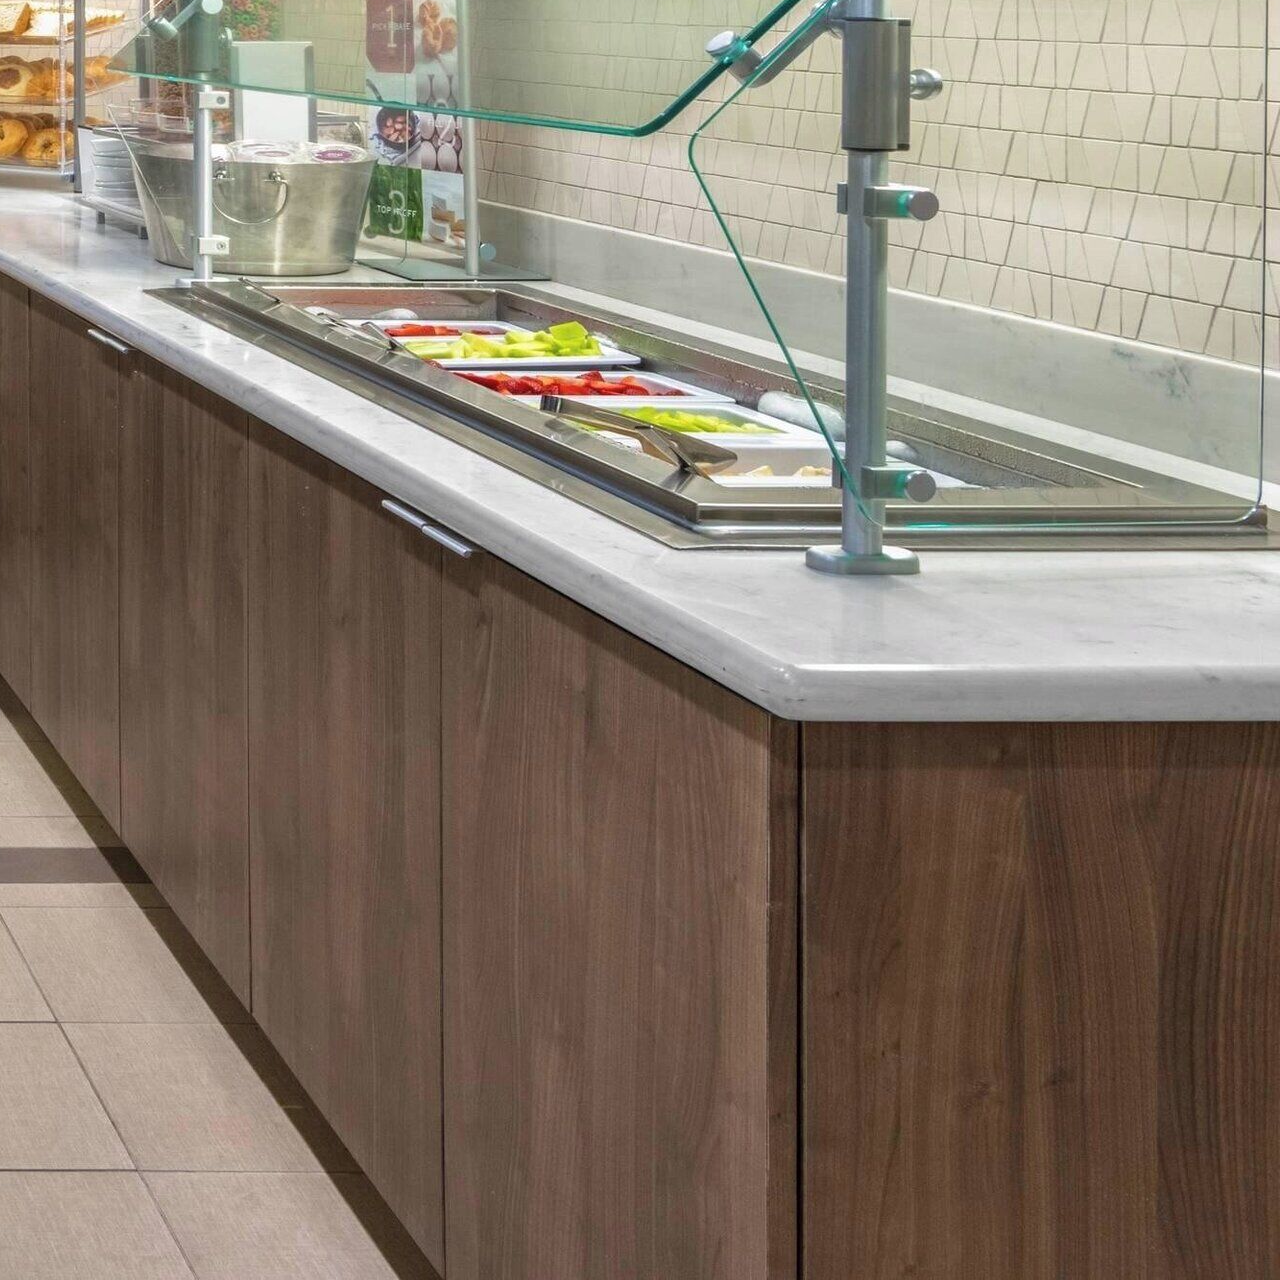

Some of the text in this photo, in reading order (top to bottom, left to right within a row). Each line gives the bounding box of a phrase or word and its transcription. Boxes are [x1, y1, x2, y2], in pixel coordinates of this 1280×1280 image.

[386, 4, 397, 48] 1
[377, 204, 392, 214] TOP
[388, 190, 406, 234] 3
